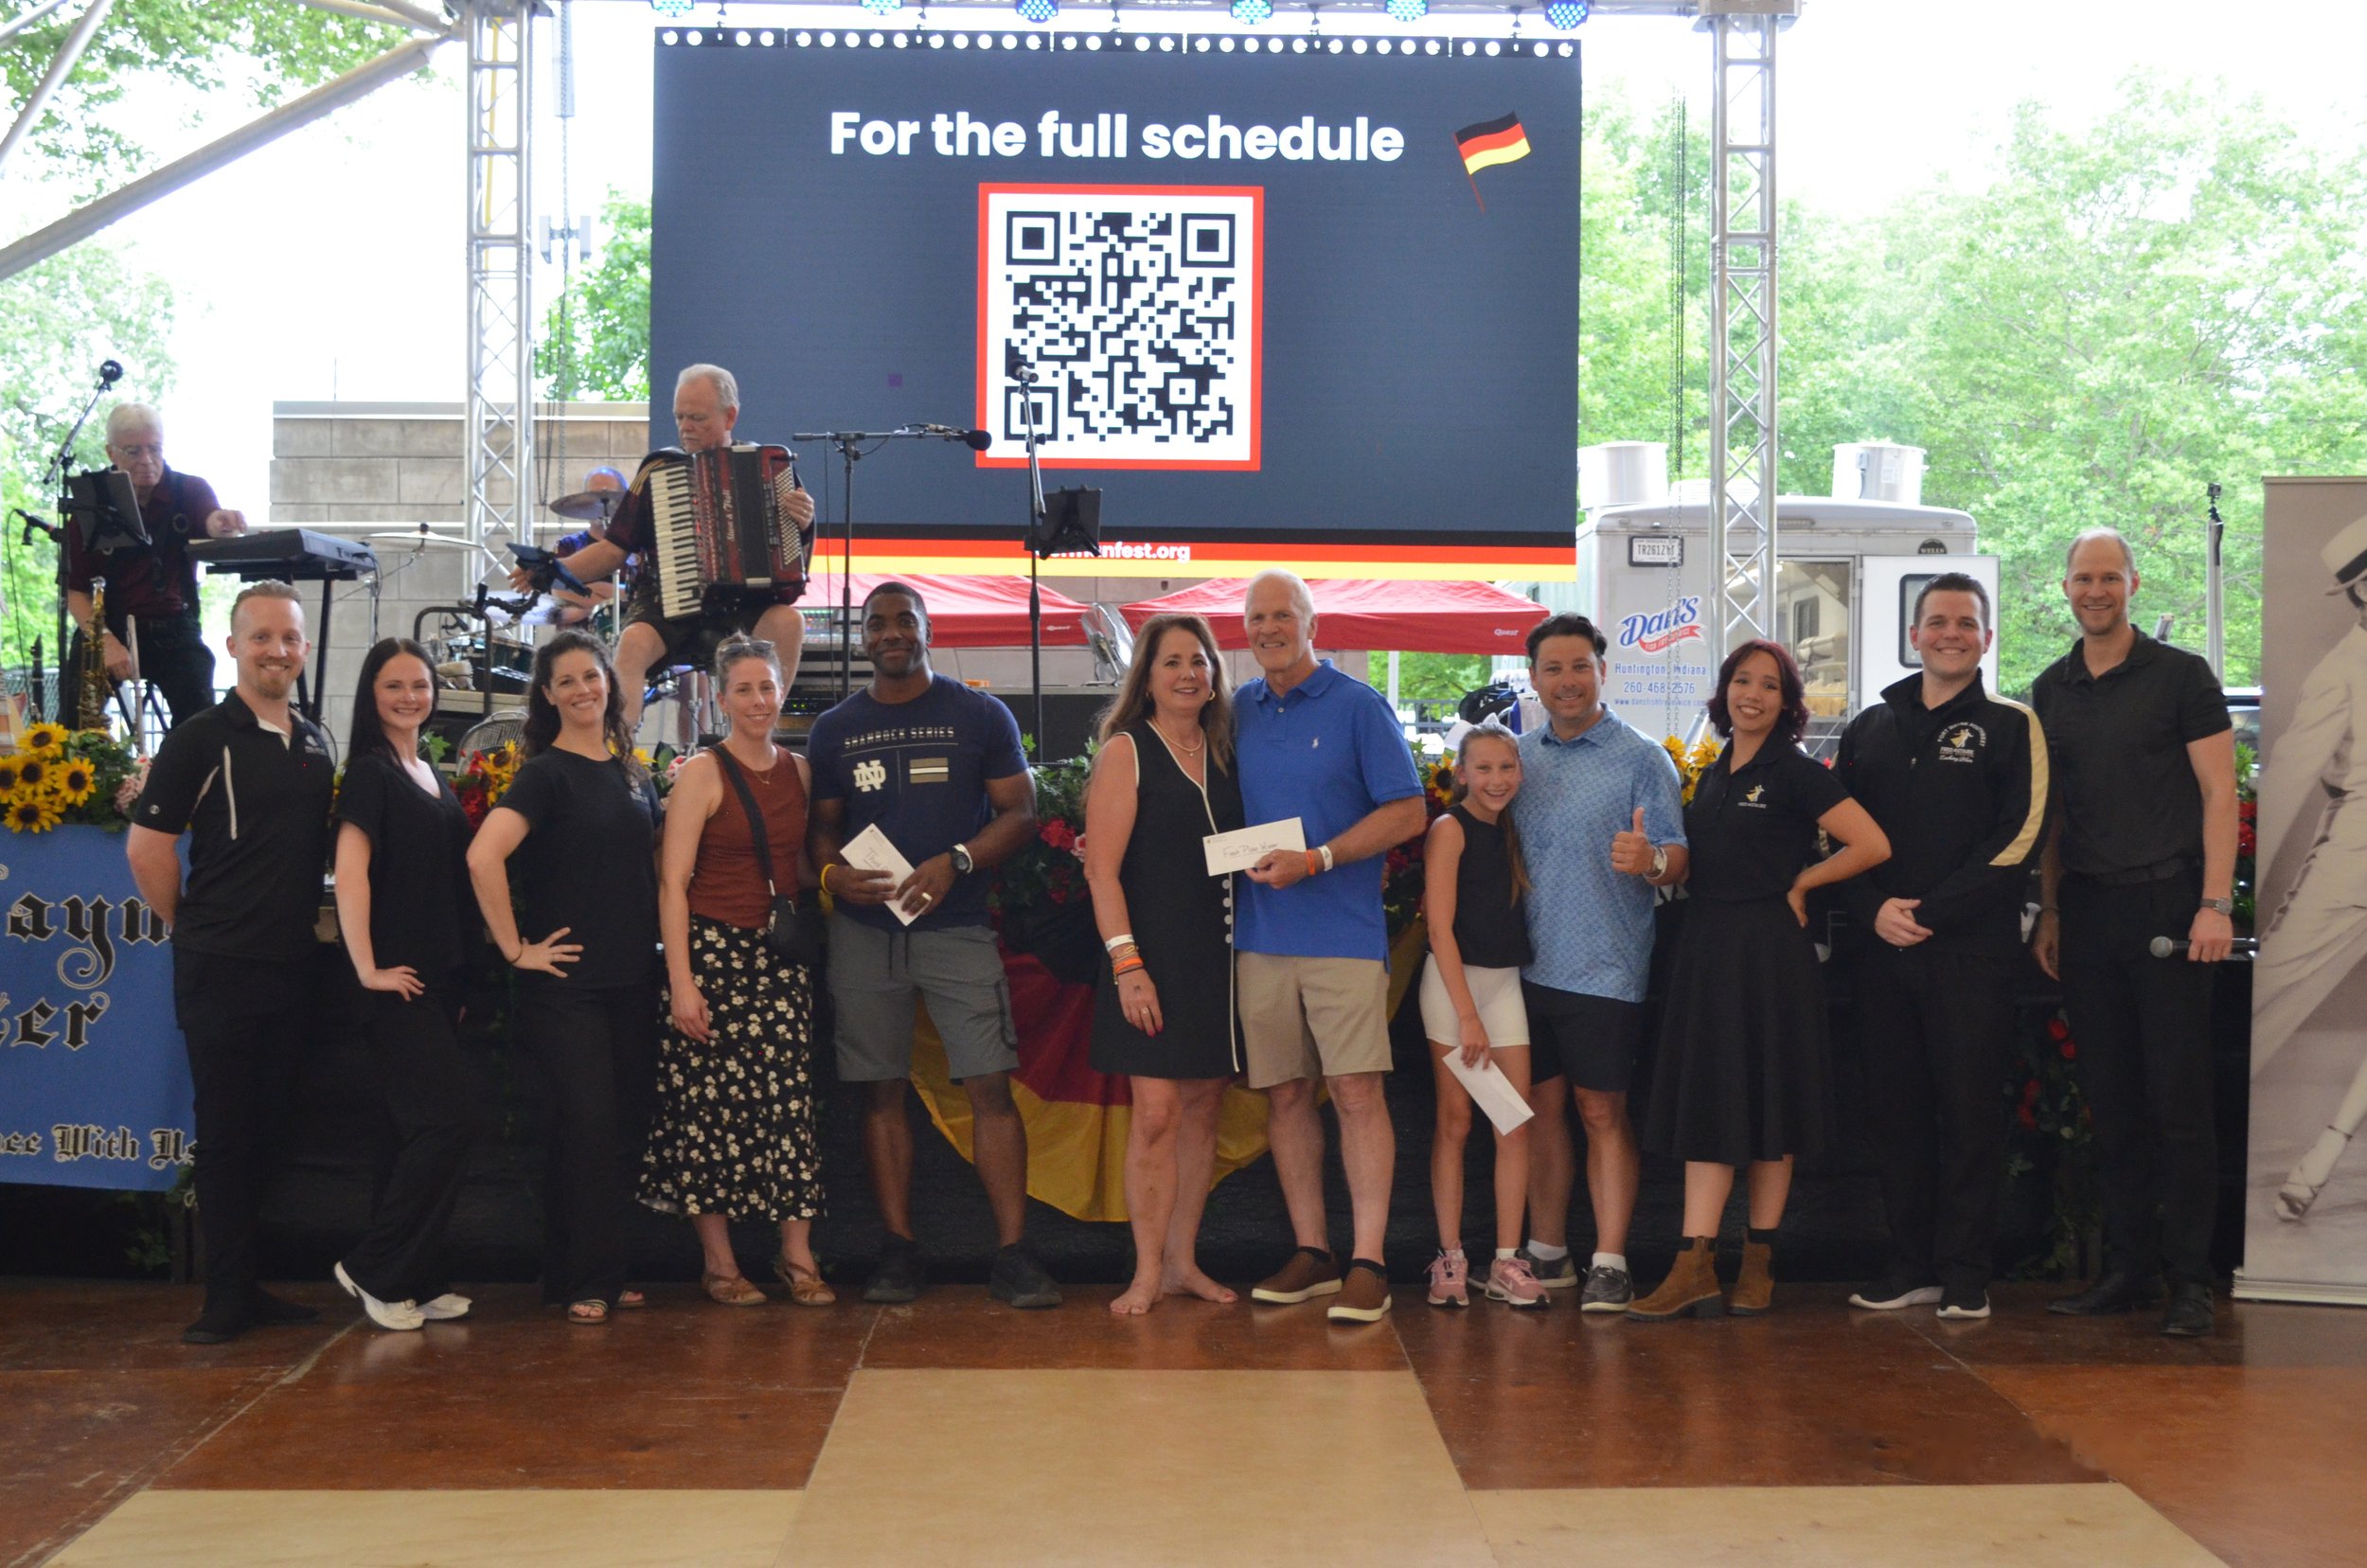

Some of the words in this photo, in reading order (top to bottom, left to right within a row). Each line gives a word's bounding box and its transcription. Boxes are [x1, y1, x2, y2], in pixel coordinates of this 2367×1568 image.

[831, 112, 920, 155] For
[931, 111, 1026, 157] the
[1038, 110, 1128, 158] full
[1141, 114, 1405, 162] schedule
[1035, 541, 1191, 563] nfest.org
[1619, 597, 1699, 647] Dan's
[845, 727, 906, 749] SHAMROCK
[910, 726, 954, 739] SERIES
[5, 891, 172, 989] ayn
[5, 991, 111, 1051] er
[51, 1123, 140, 1163] With
